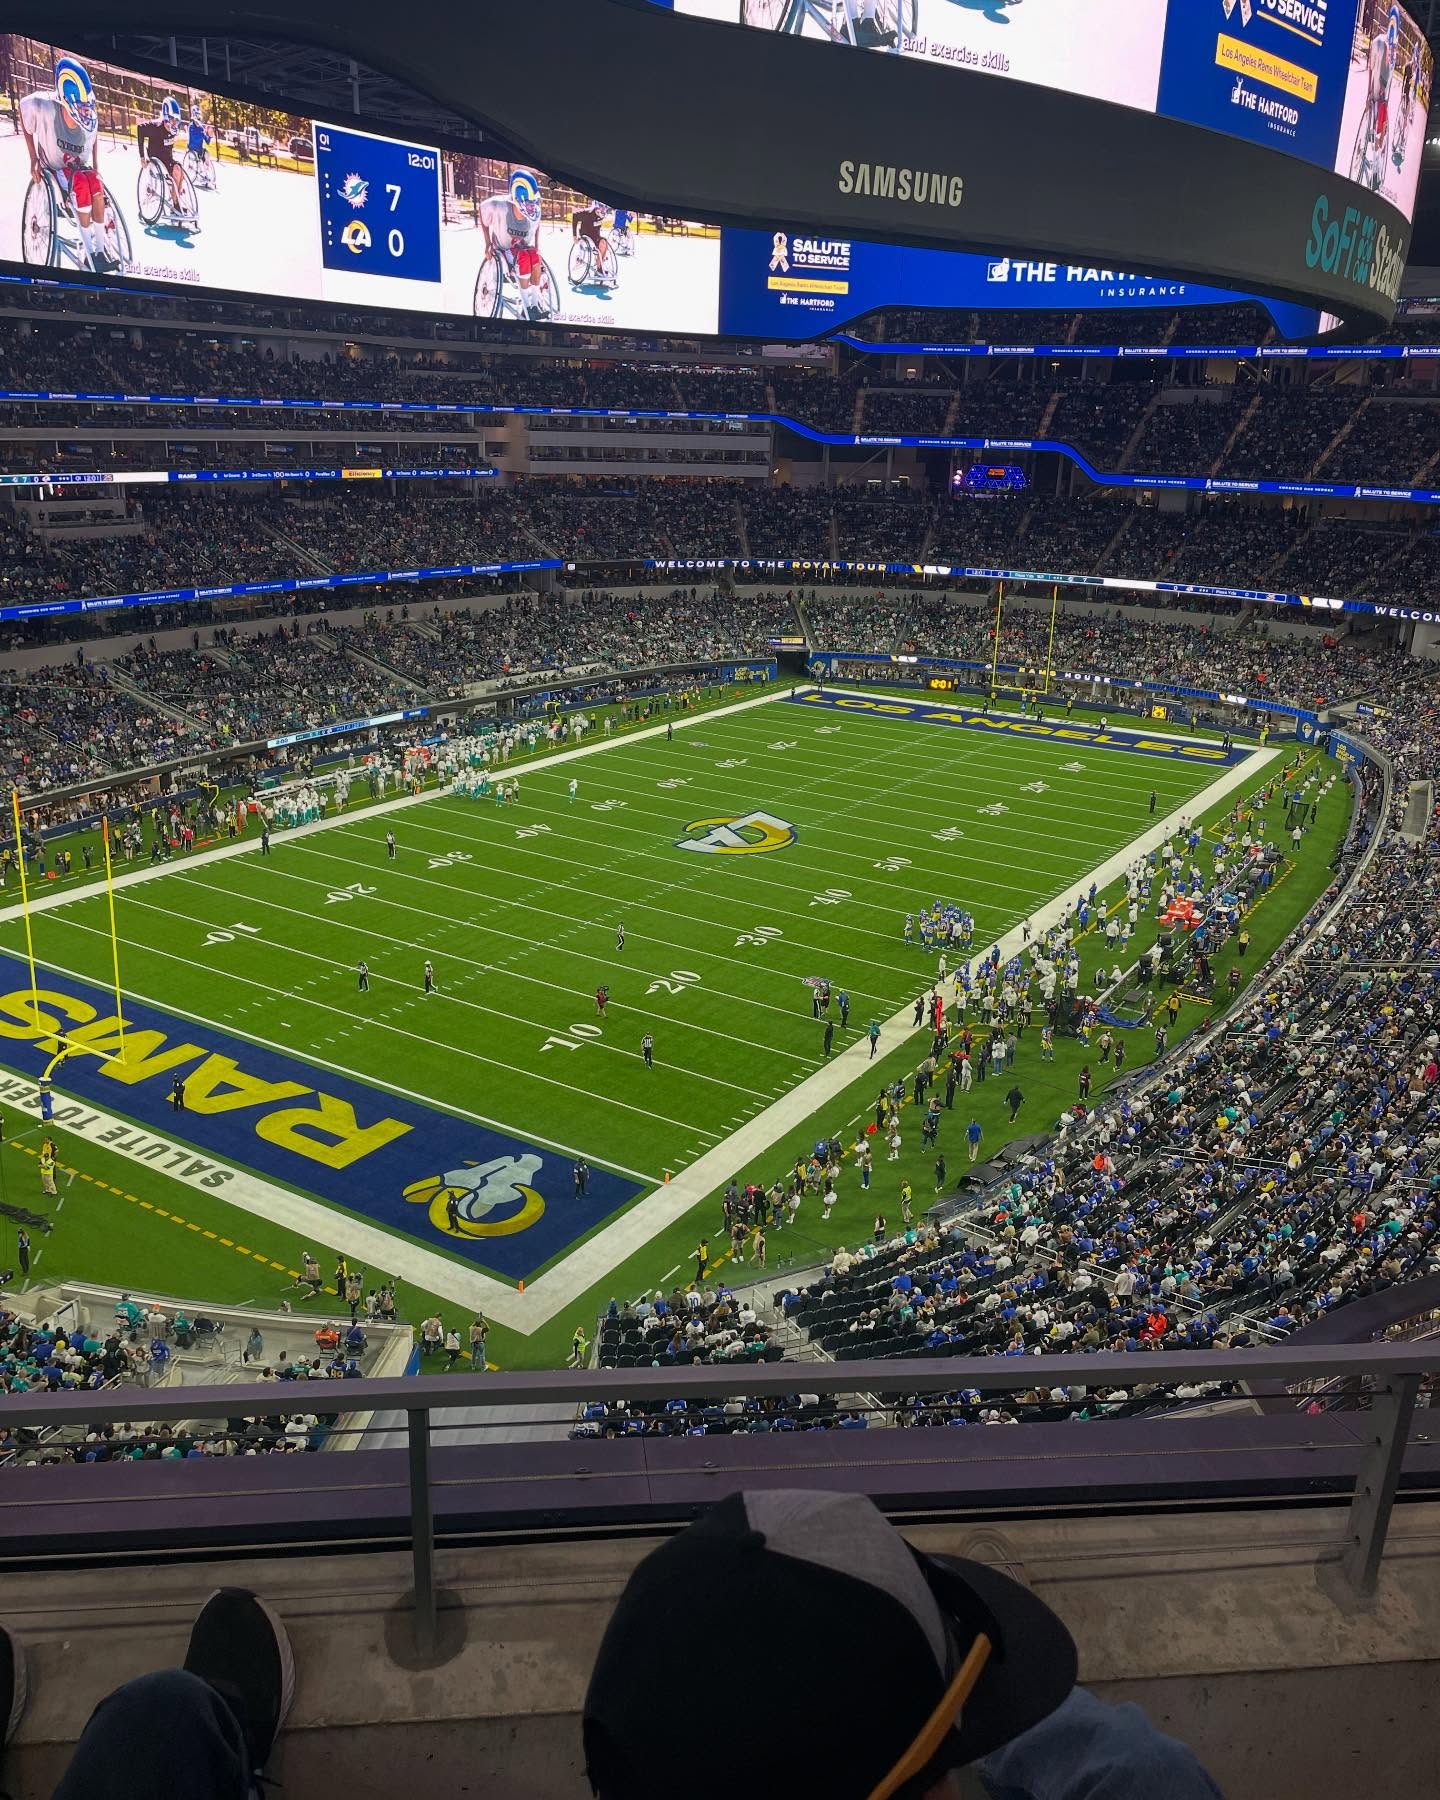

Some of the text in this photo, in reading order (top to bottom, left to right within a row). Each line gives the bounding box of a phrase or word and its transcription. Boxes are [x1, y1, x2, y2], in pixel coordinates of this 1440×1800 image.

[1277, 0, 1326, 36] SERVICE
[903, 36, 1010, 72] and exercise skills
[1221, 42, 1313, 92] Los Angeles Rams Wheelchair Team
[1241, 89, 1299, 125] THE HARTFORD
[407, 153, 435, 170] 12:01
[838, 160, 964, 207] SAMSUNG
[385, 183, 402, 212] 7
[388, 228, 405, 258] 0
[792, 238, 851, 256] SALUTE
[1305, 194, 1361, 279] SoFi
[124, 261, 141, 275] and
[143, 265, 178, 280] exercise
[792, 253, 850, 266] TO SERVICE
[1012, 262, 1057, 282] THE
[787, 297, 835, 307] THE HARTFORD
[1100, 285, 1186, 297] INSURANCE
[655, 560, 887, 571] WELCOME TO THE ROYAL TOUR
[801, 694, 915, 714] LOS
[921, 712, 1230, 759] ANGELES
[431, 850, 474, 868] 30
[873, 856, 913, 873] 50
[327, 882, 378, 903] 20
[812, 888, 853, 907] 40
[206, 922, 263, 944] 10
[737, 926, 784, 946] 30
[648, 970, 702, 994] 20
[546, 1023, 603, 1051] 10
[0, 989, 414, 1170] RAMS
[52, 1105, 102, 1131] TO
[96, 1125, 235, 1188] SALUTE
